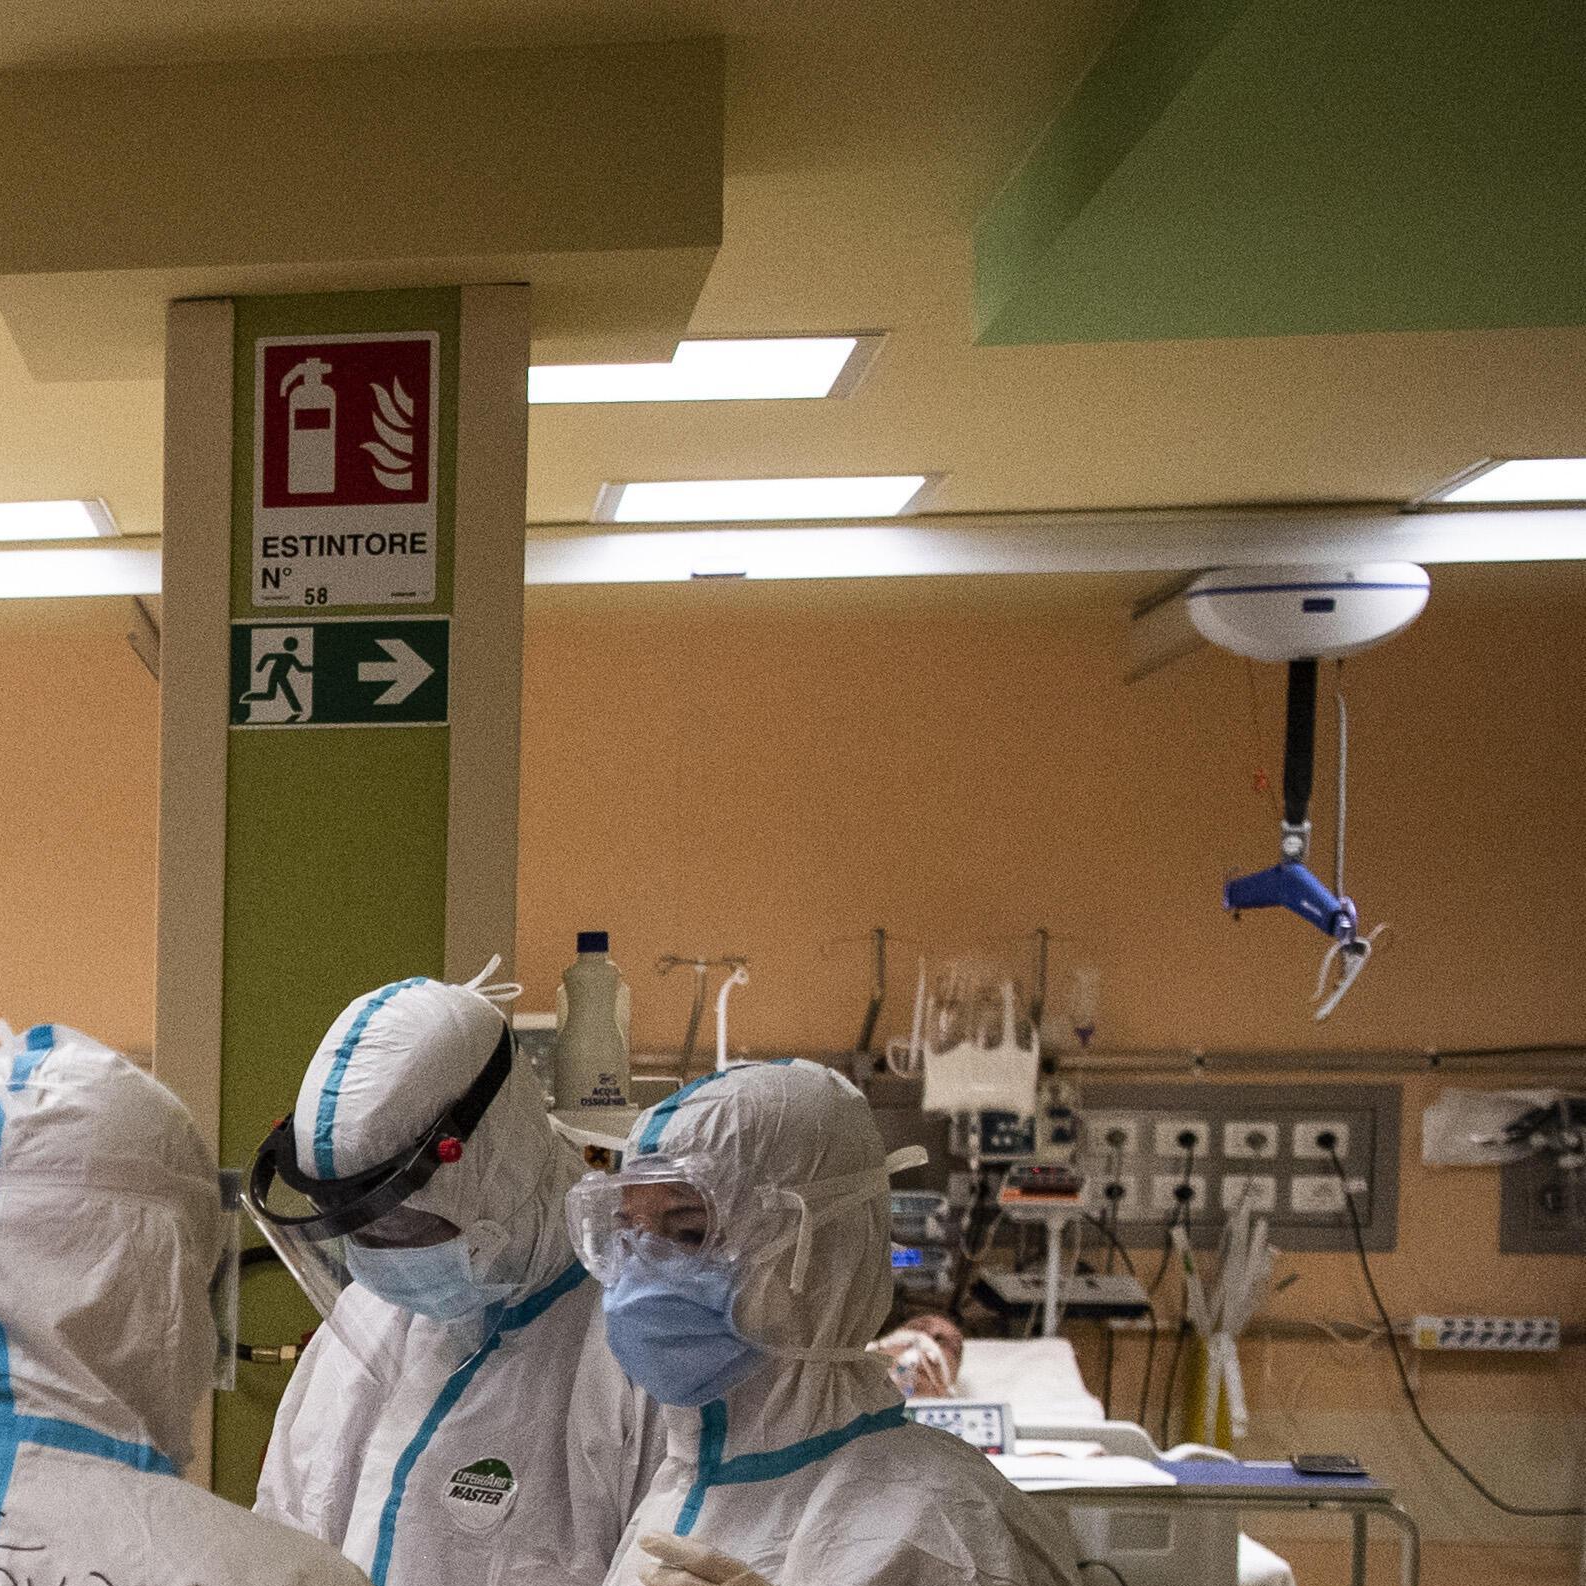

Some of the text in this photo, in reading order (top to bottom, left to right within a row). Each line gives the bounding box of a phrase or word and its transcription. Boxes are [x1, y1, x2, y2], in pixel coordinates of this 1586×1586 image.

[262, 532, 427, 558] ESTINTORE
[261, 566, 292, 589] N°
[304, 587, 328, 605] 58
[591, 1086, 621, 1097] ACQUA
[455, 1470, 508, 1489] LIFEGUARD
[449, 1485, 504, 1506] MASTER
